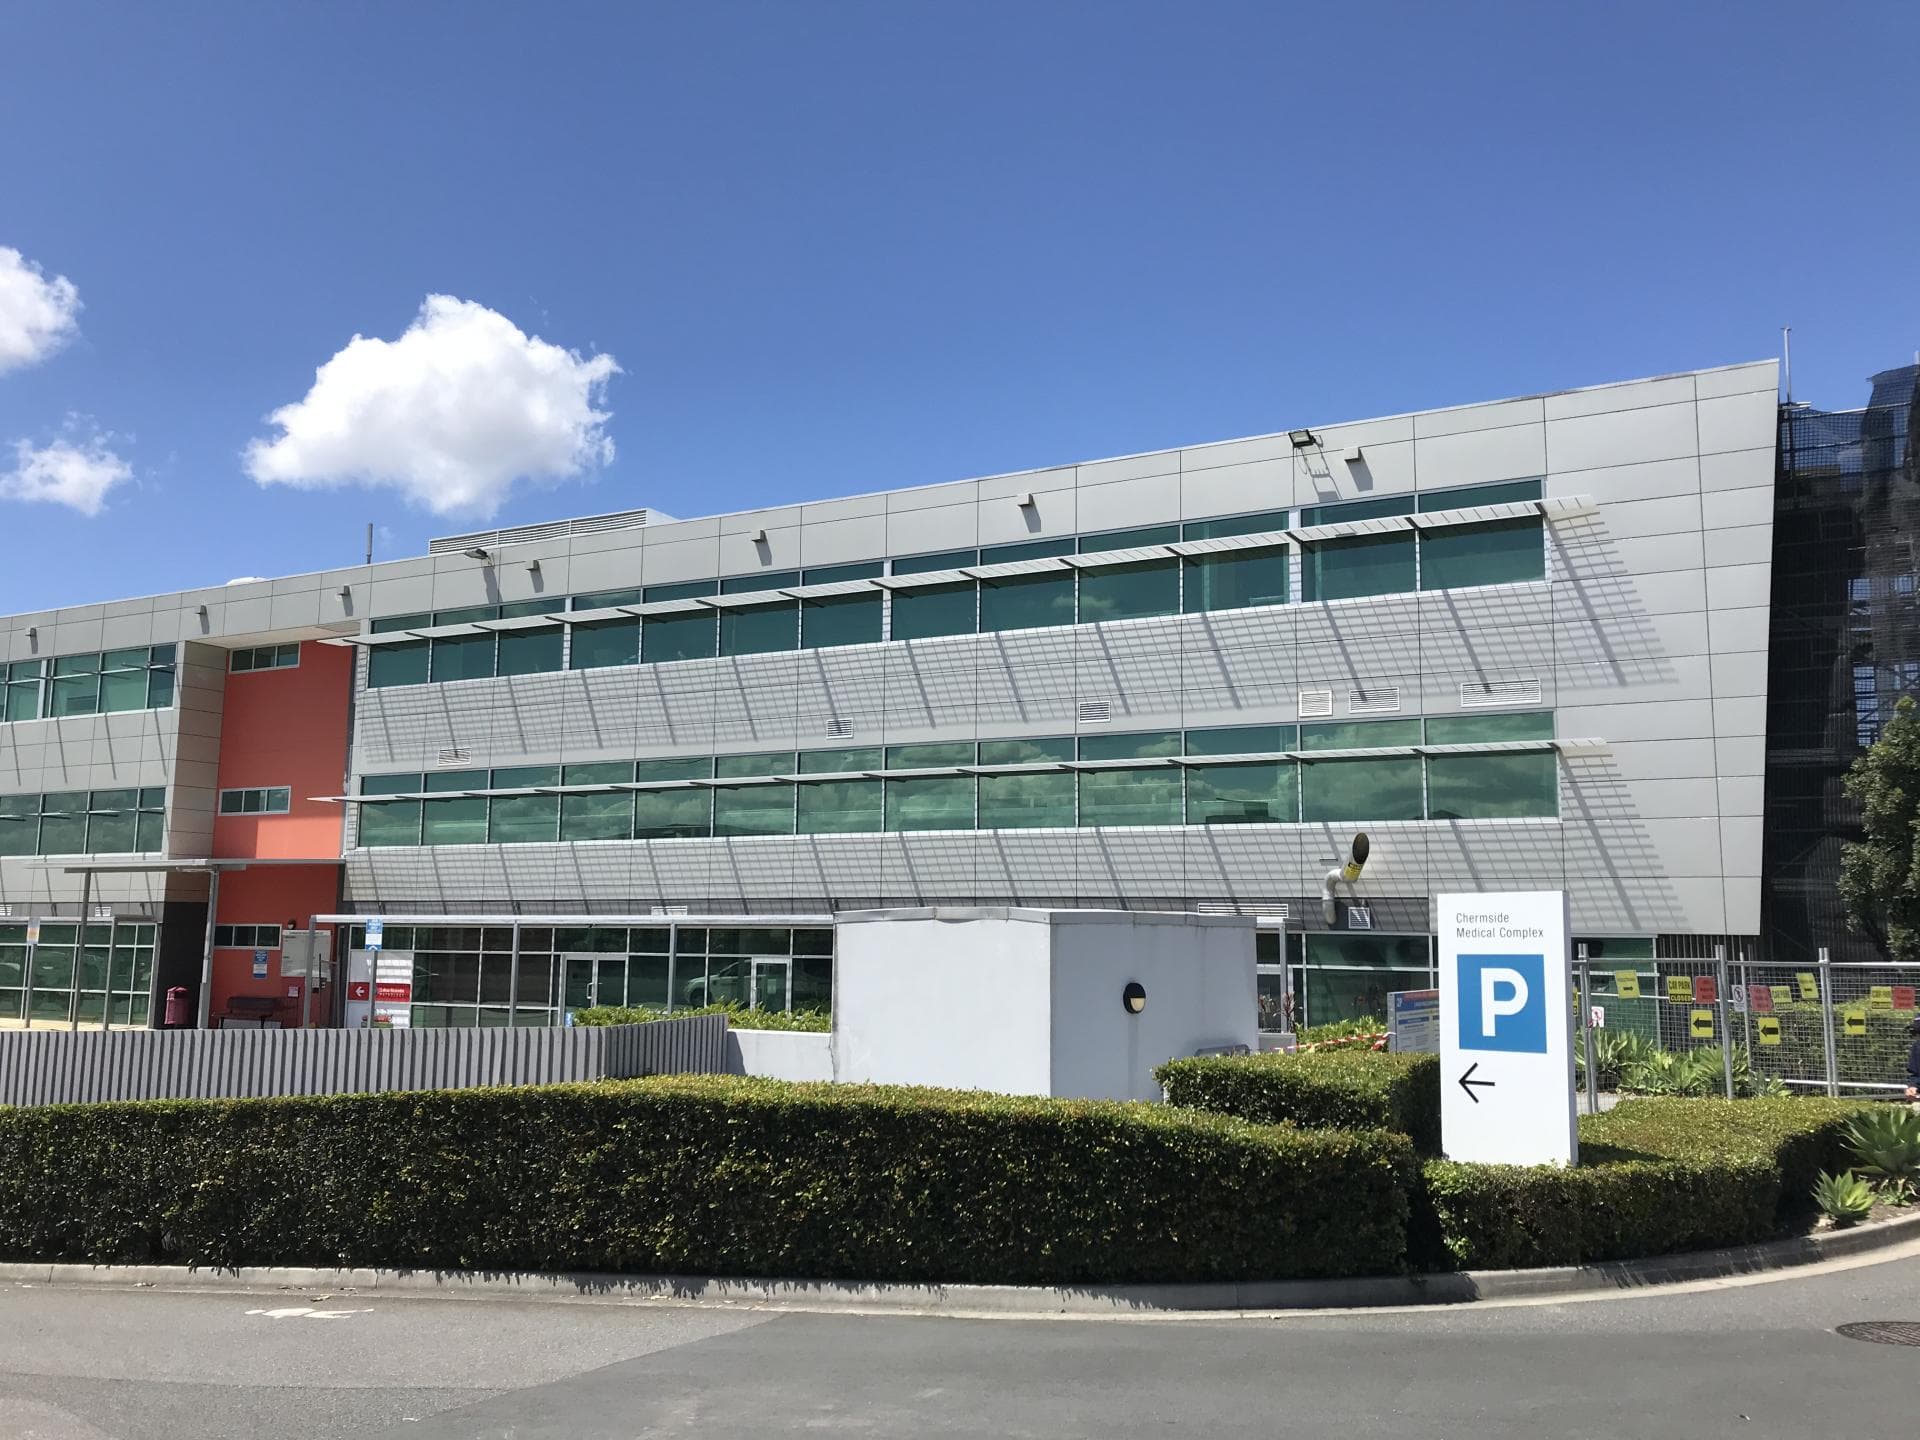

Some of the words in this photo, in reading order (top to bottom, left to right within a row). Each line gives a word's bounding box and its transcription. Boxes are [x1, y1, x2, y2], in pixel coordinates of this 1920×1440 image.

[1456, 912, 1510, 923] Chermside
[1456, 927, 1496, 938] Medical
[1499, 927, 1544, 940] Complex
[1678, 980, 1691, 990] PARK
[1481, 968, 1529, 1037] P
